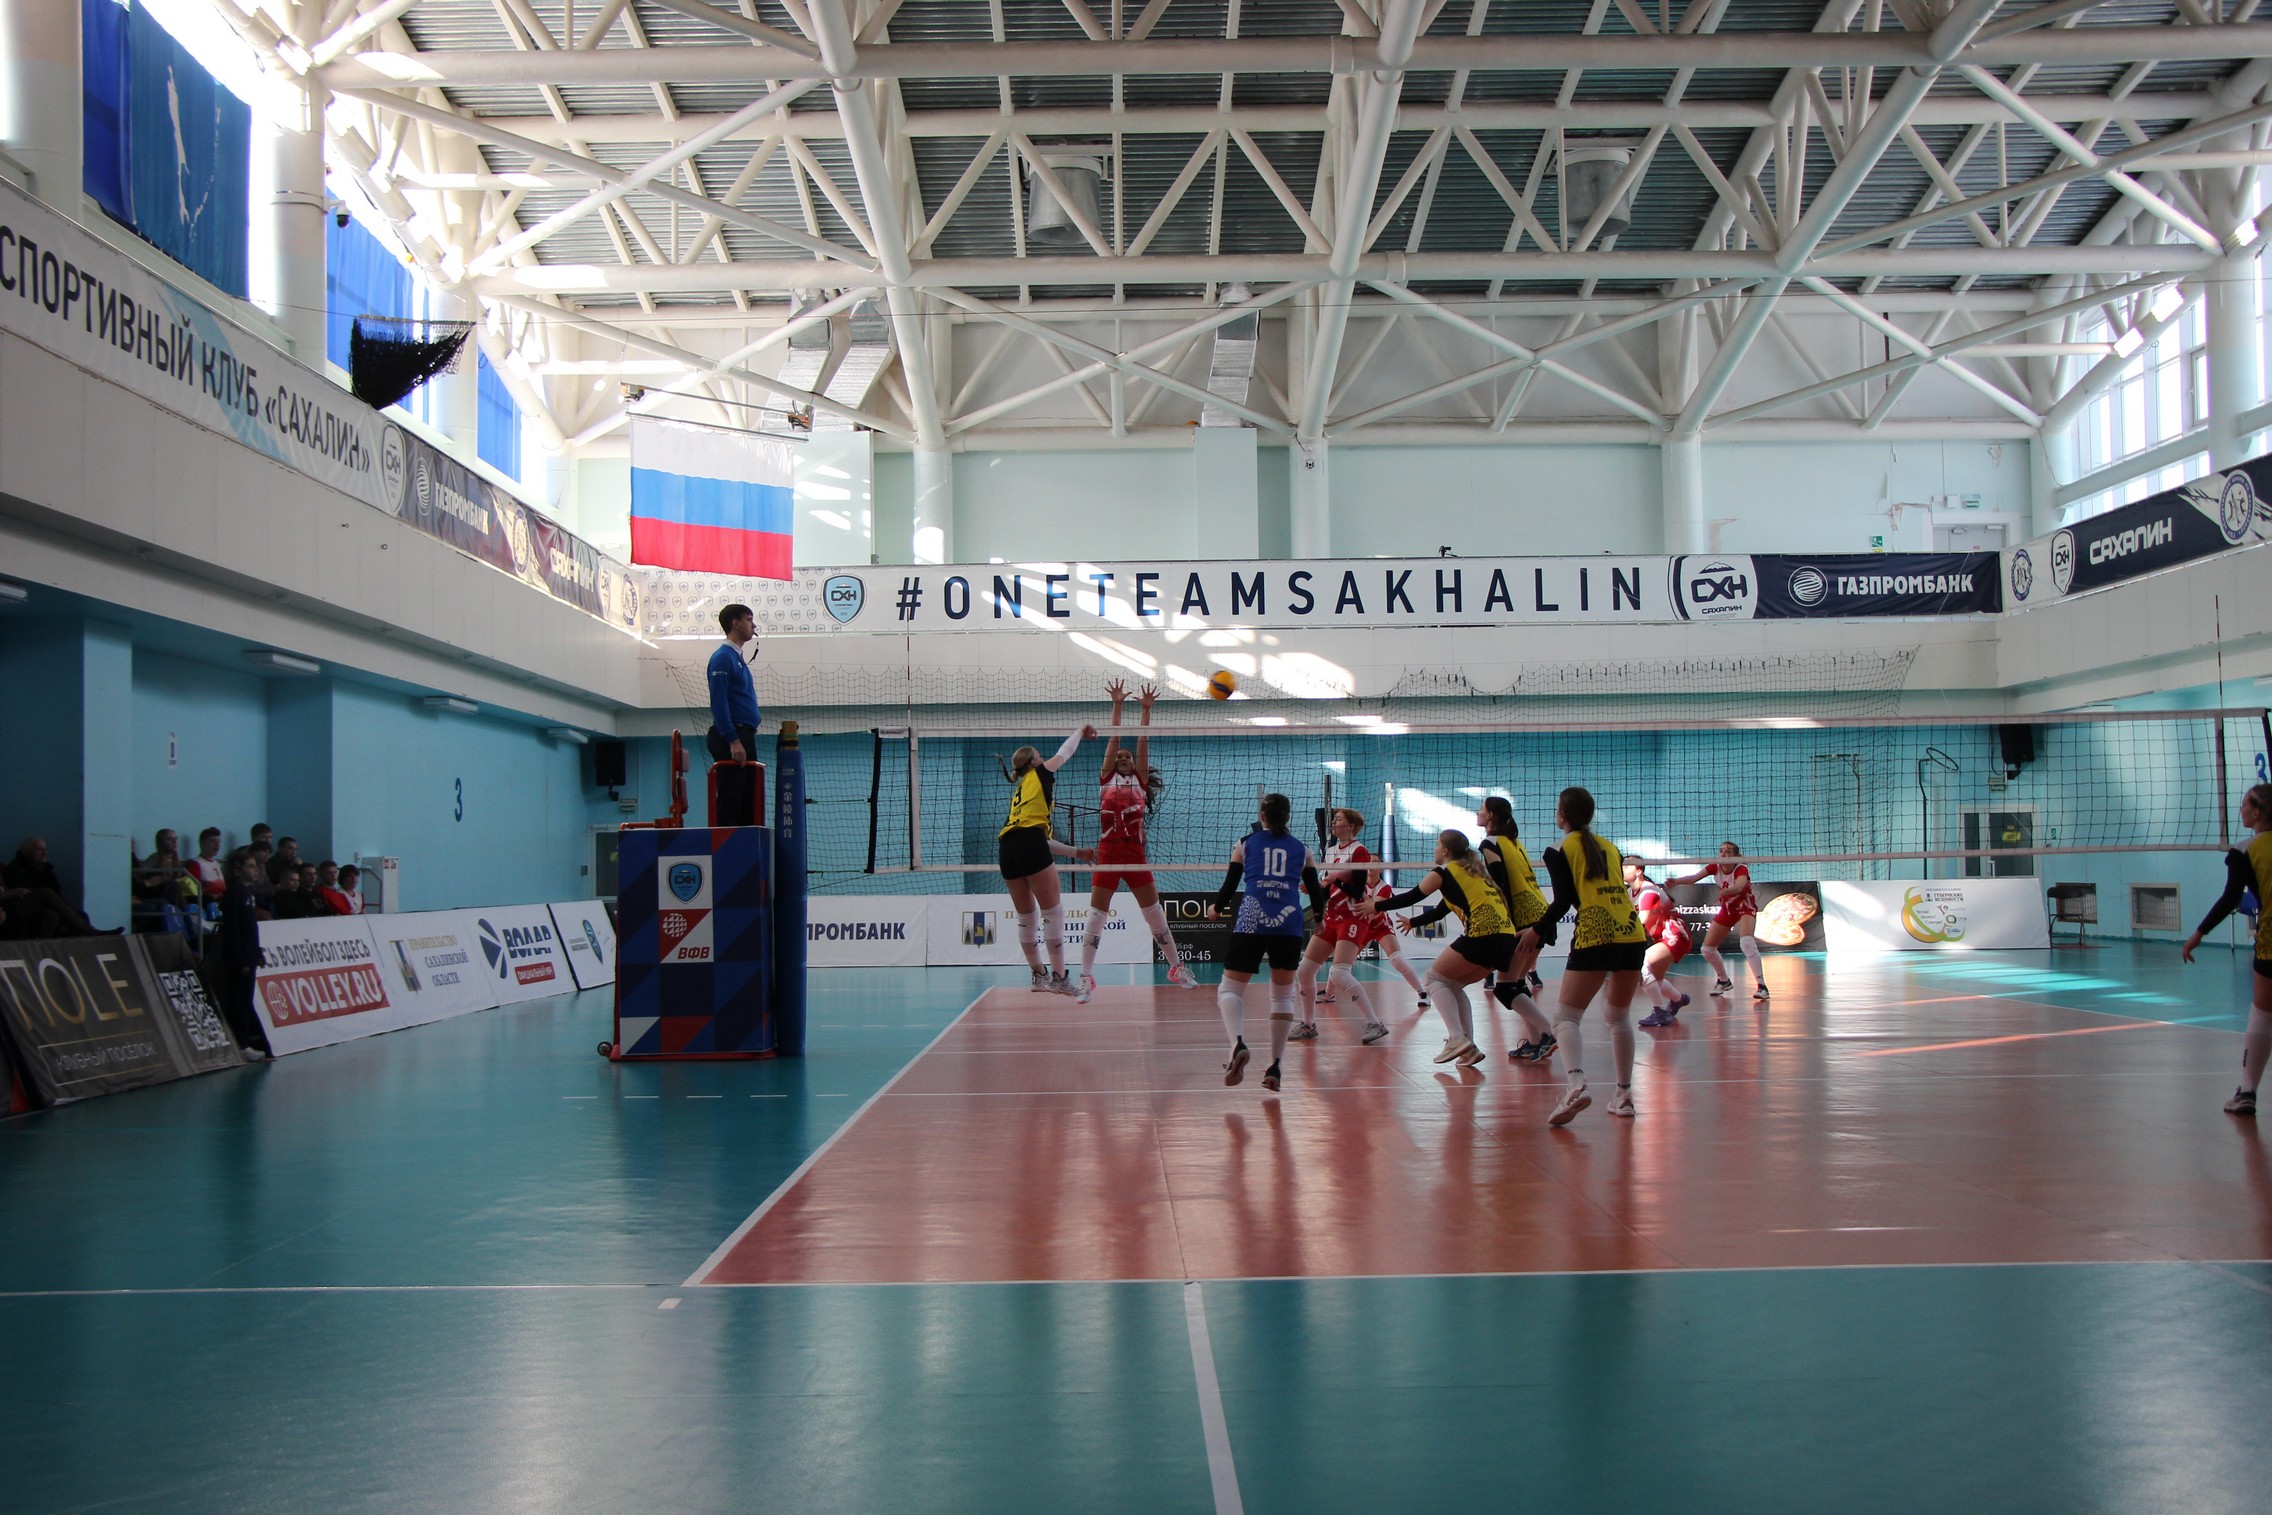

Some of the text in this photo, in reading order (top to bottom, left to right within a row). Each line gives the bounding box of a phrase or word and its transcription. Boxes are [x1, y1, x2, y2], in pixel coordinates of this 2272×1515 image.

[0, 225, 371, 473] СПОРТИВНЫЙ КЛУБ «САХАЛИН»
[436, 481, 488, 535] ГАЗПРОМБАНК
[2089, 517, 2172, 565] САХАЛИН
[1837, 574, 1974, 596] ГАЗПРОМБАНК
[1701, 605, 1742, 615] САХАЛИН
[454, 777, 463, 822] 3
[1263, 847, 1287, 877] 10
[276, 938, 340, 967] ВОЛЕЙБОЛ
[336, 938, 371, 962] ЗДЕСЬ
[678, 946, 710, 959] ВФВ
[281, 969, 382, 1016] VOLLEY.RU
[55, 1046, 108, 1071] КЛУБНЫЙ
